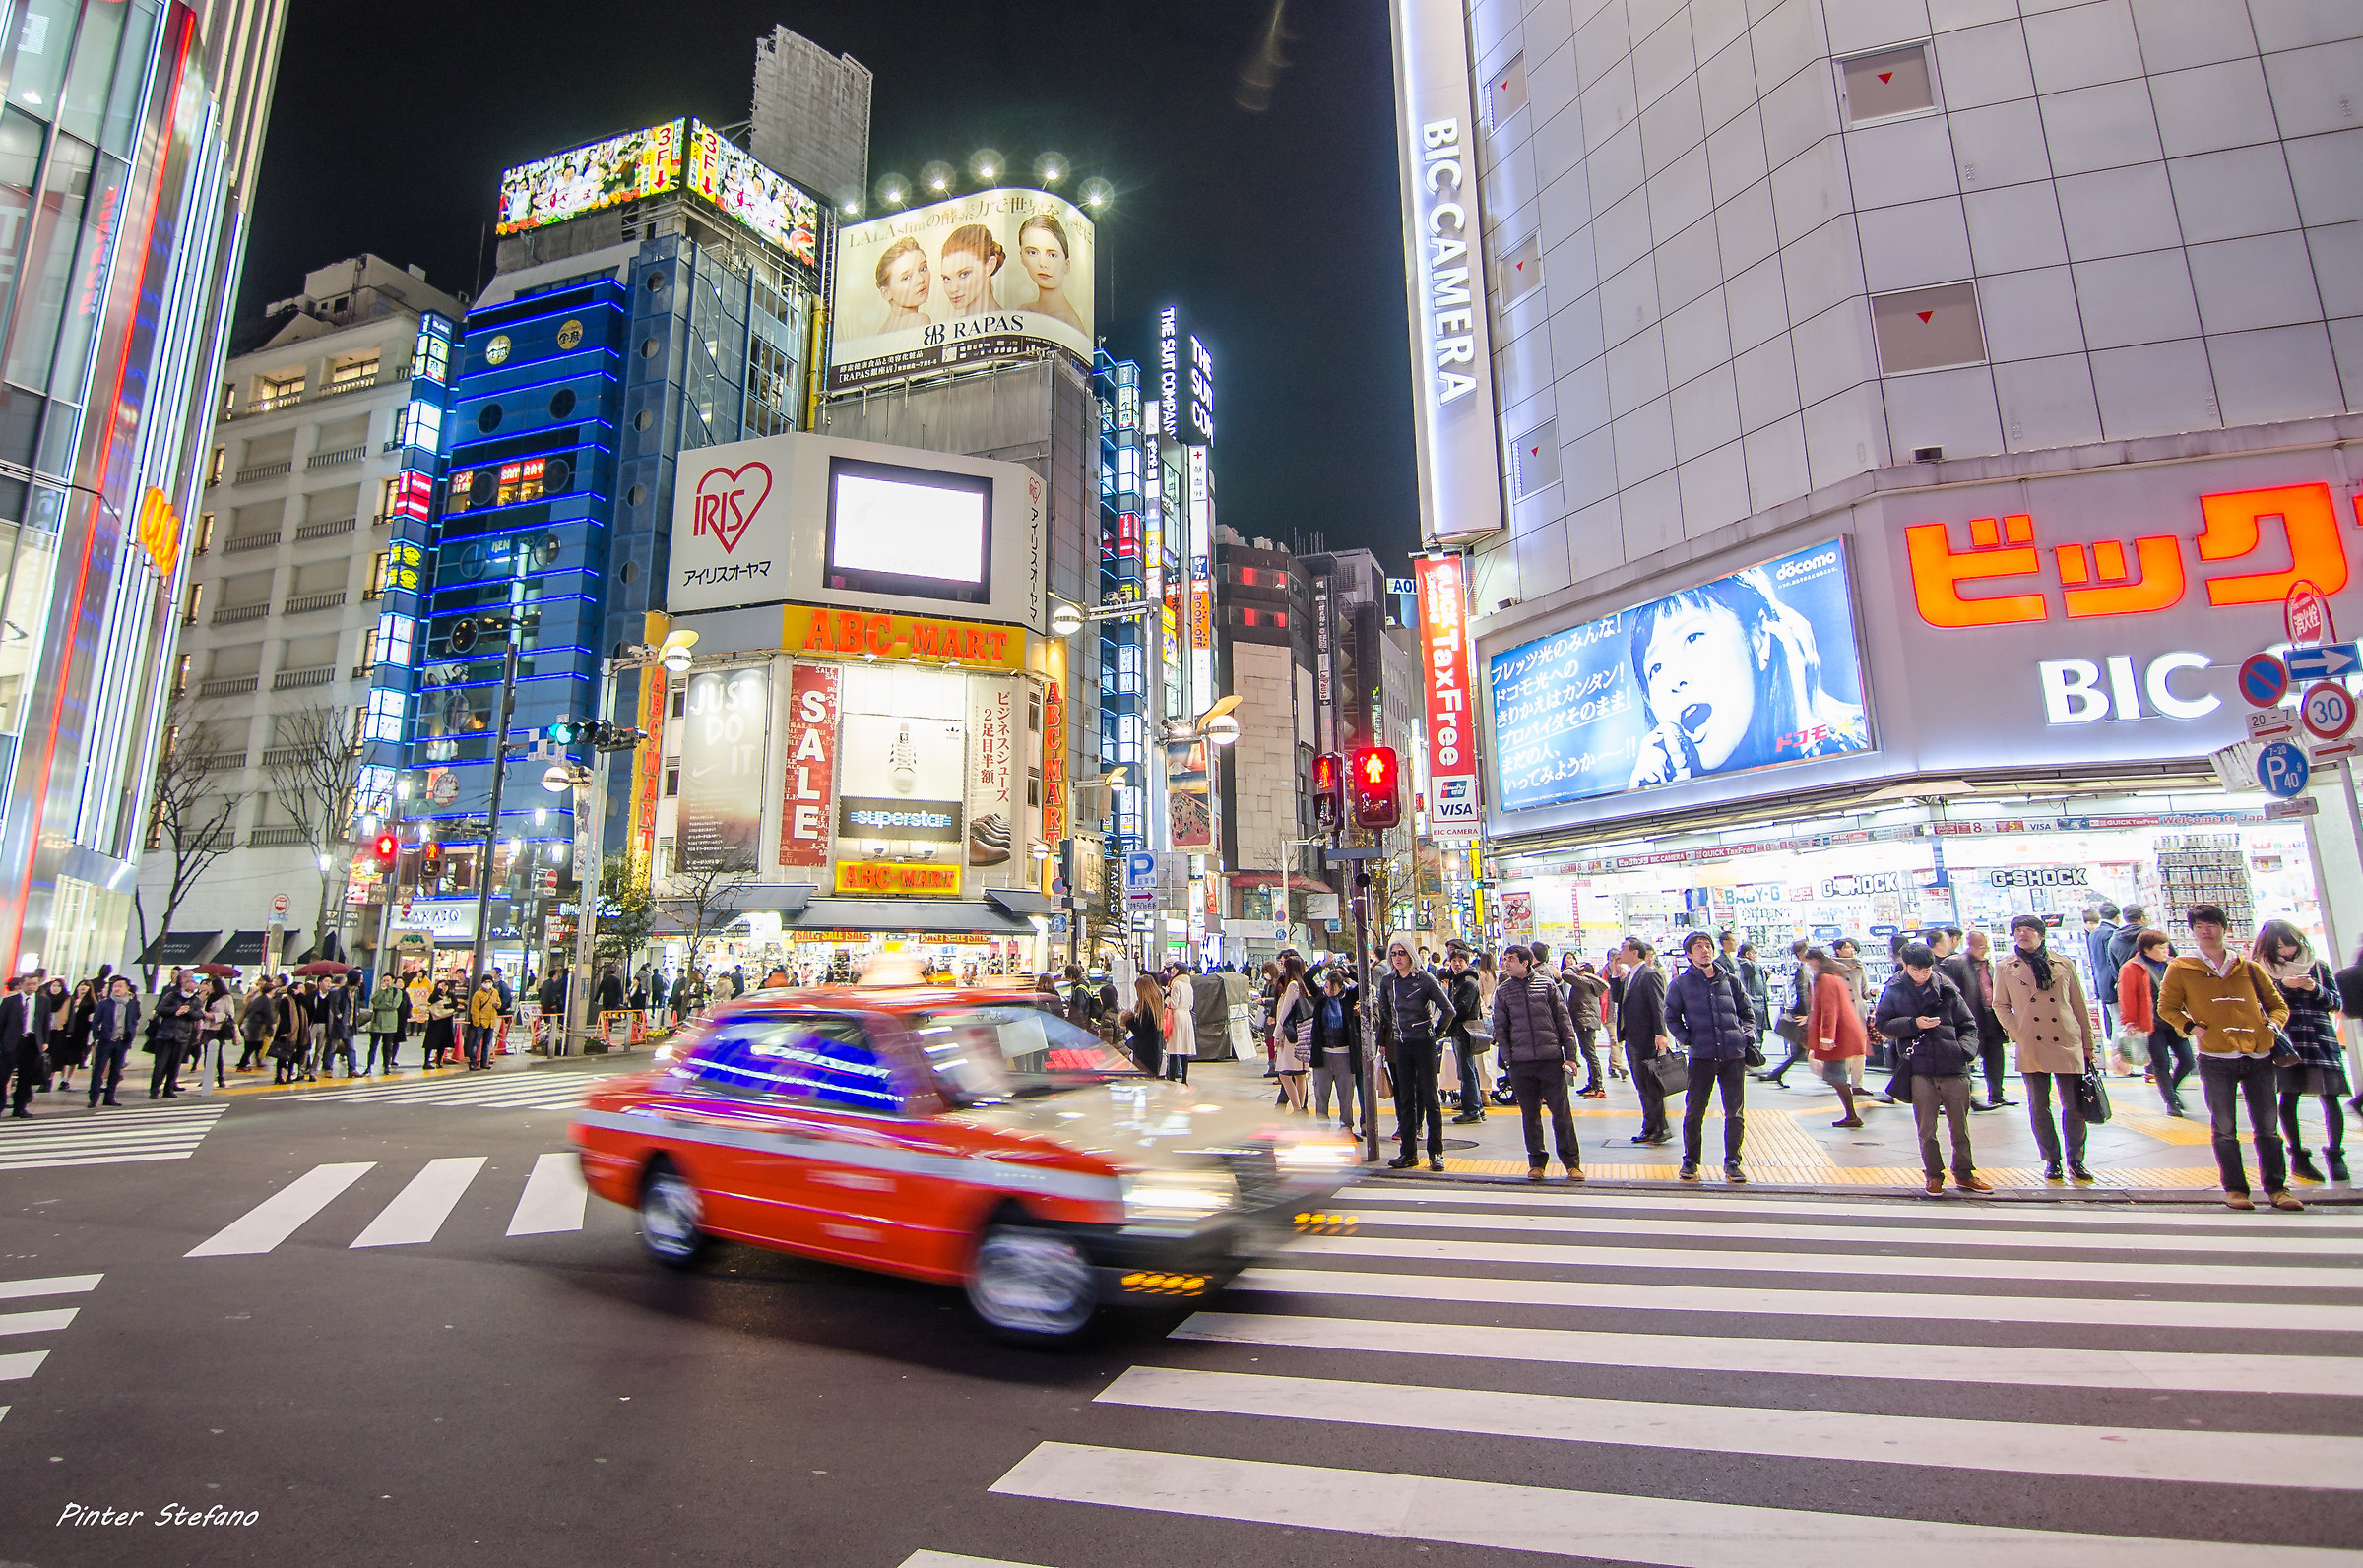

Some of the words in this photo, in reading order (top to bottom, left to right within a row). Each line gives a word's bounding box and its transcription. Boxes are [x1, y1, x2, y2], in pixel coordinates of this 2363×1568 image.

[658, 128, 671, 166] 3F
[704, 133, 717, 169] 3F
[1422, 116, 1463, 195] BIC
[1161, 305, 1176, 337] THE
[1428, 201, 1478, 408] CAMERA
[953, 314, 1024, 340] RAPAS
[1161, 338, 1177, 370] SUIT
[1190, 334, 1213, 382] THE
[1191, 366, 1214, 412] SUIT
[683, 560, 772, 587] アイリスオーヤマ
[1029, 506, 1039, 623] アイリスオーヤマ
[1776, 551, 1837, 581] docomo
[1905, 482, 2363, 630] ビック
[1393, 580, 1417, 594] AO
[1437, 564, 1459, 628] QUICK
[802, 608, 1009, 662] ABC-MART
[2292, 603, 2321, 638] 消火栓
[1492, 612, 1623, 686] フレッツ光のみんな!
[689, 680, 757, 716] JUST
[1496, 659, 1579, 708] ドコモ光への
[1497, 661, 1625, 729] きりかえはカンタン!
[2038, 652, 2222, 726] BIC
[1499, 685, 1631, 752] プロバイダそのまま!
[2312, 697, 2343, 724] 30
[705, 713, 744, 746] DO
[981, 708, 995, 784] 2足目半額
[995, 691, 1011, 803] ビジネスシューズ
[793, 689, 827, 840] SALE
[1044, 682, 1062, 852] ABC-MART
[2268, 745, 2287, 755] 7-20
[2266, 755, 2287, 791] P
[854, 809, 949, 830] superstar
[1437, 803, 1473, 816] VISA
[2163, 815, 2220, 825] Welcome
[2240, 813, 2268, 824] Japa
[1130, 853, 1154, 885] P
[1702, 848, 1724, 858] QUICK
[842, 864, 955, 890] ABC-MART
[1990, 867, 2088, 887] G-SHOCK
[822, 931, 844, 940] SALE
